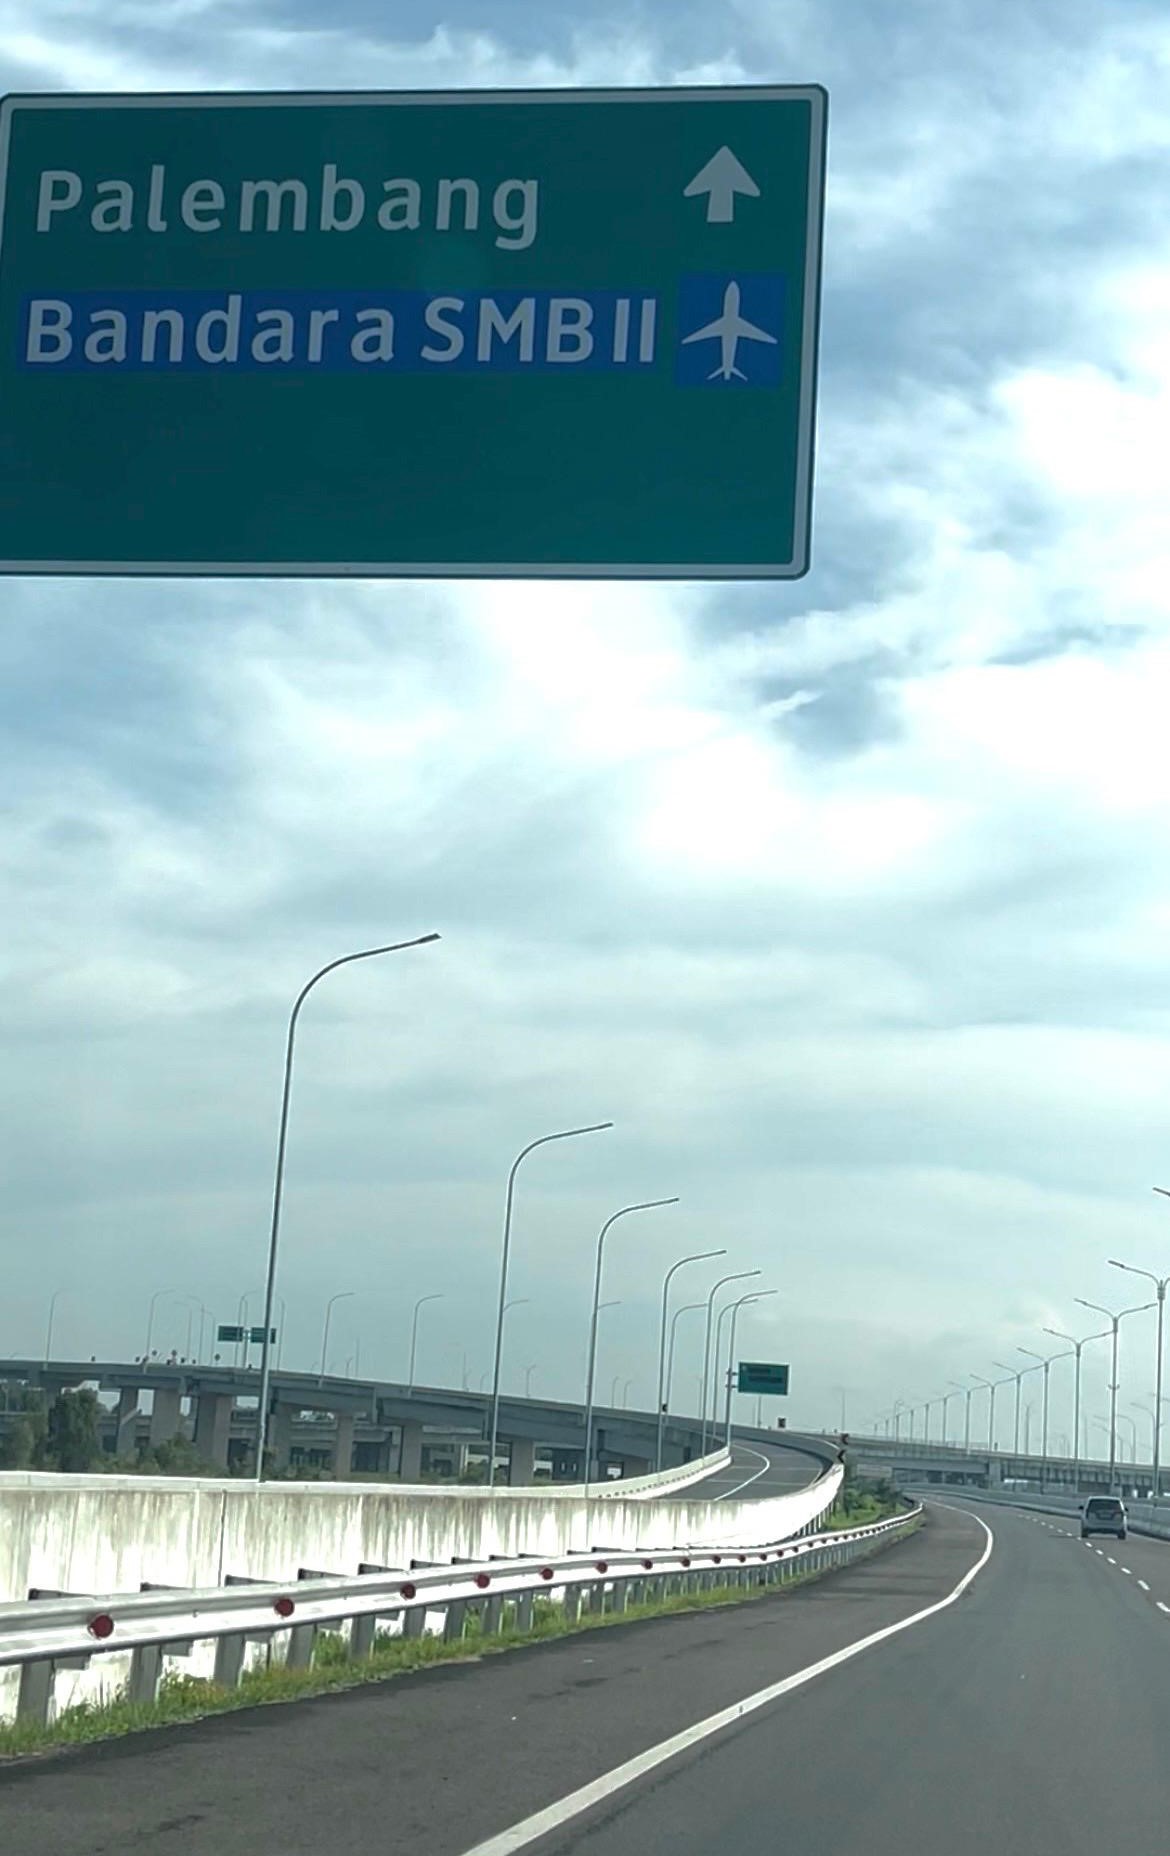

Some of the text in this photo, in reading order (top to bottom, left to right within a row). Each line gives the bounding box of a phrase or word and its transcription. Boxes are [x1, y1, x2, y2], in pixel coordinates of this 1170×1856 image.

[37, 164, 539, 250] Palembang
[26, 295, 395, 363] Bandara
[421, 297, 594, 363] SMB
